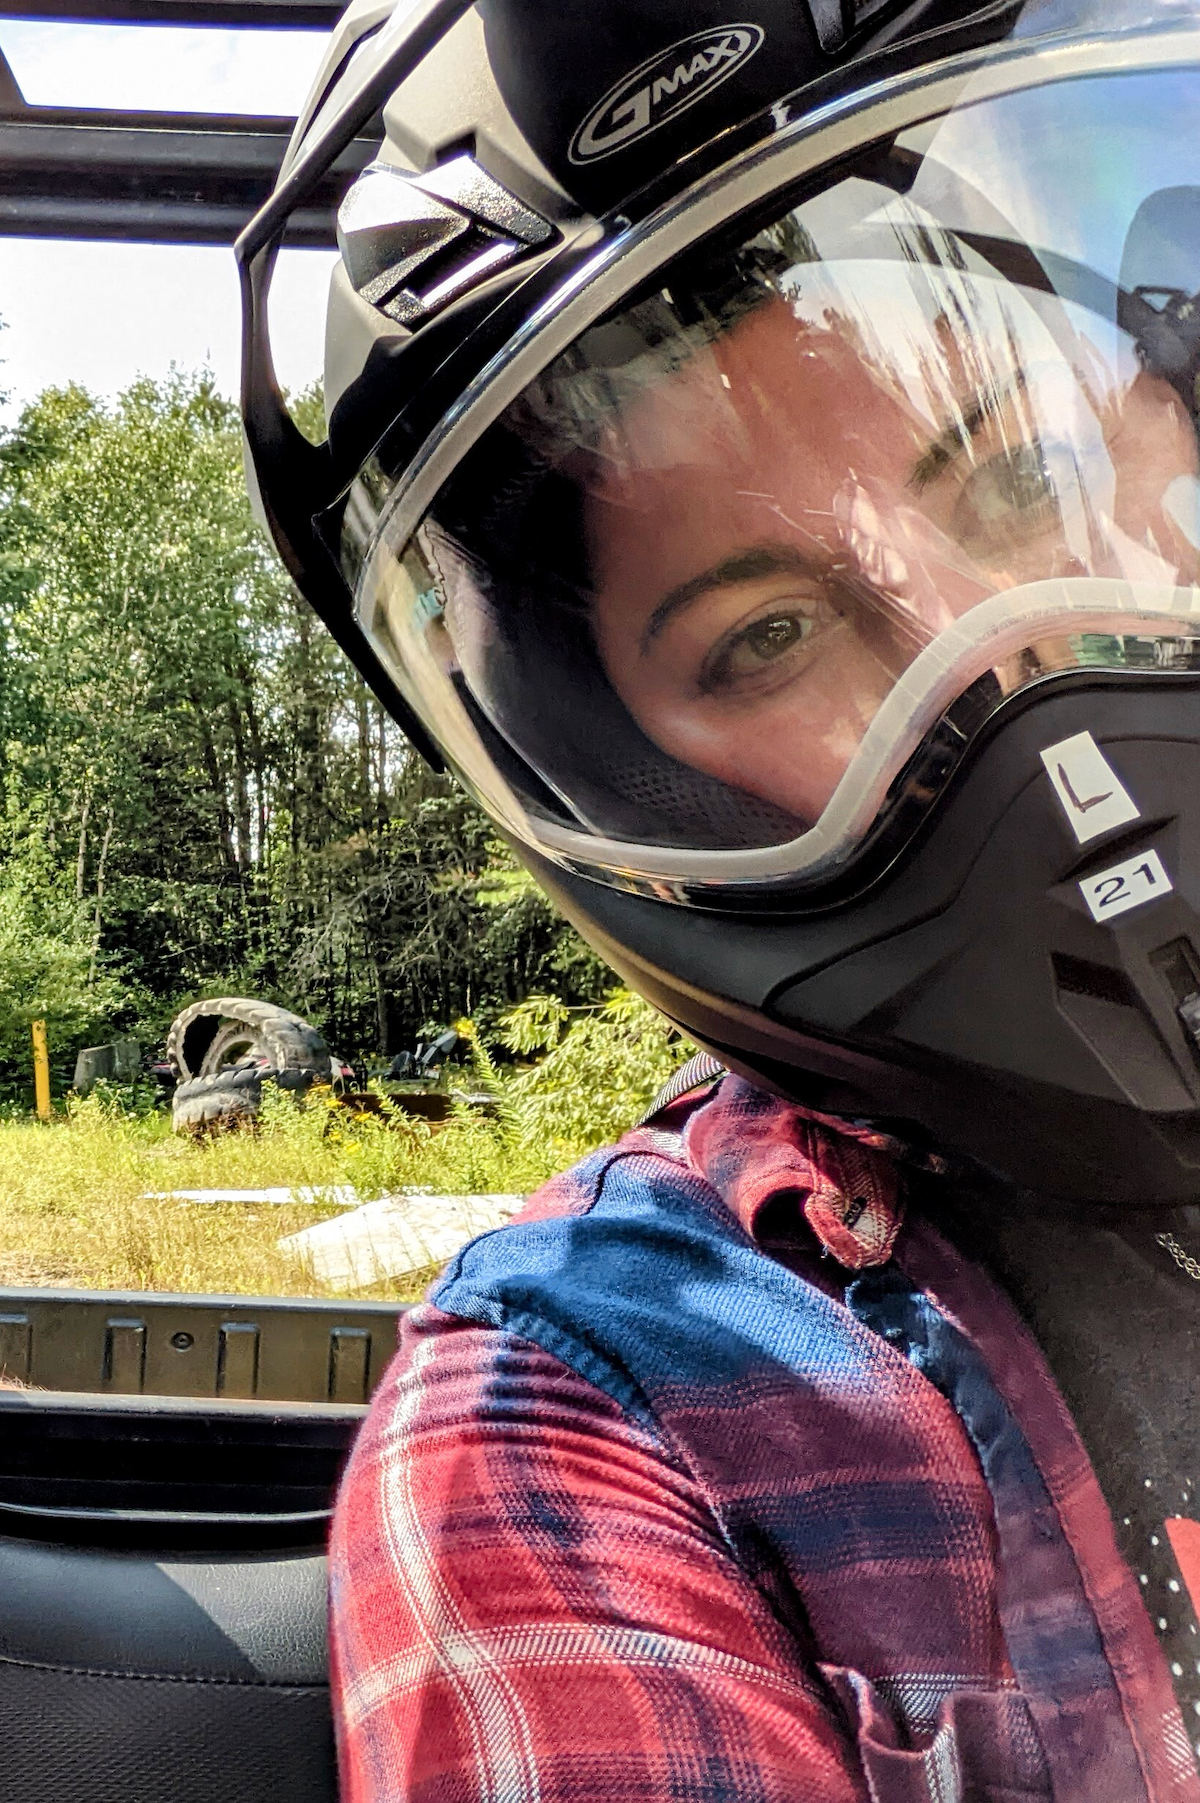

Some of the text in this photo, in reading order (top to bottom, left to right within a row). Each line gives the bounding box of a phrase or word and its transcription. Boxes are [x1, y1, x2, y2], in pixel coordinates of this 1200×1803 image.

[576, 29, 752, 156] GMAX
[1056, 762, 1114, 814] L
[1093, 862, 1157, 908] 21
